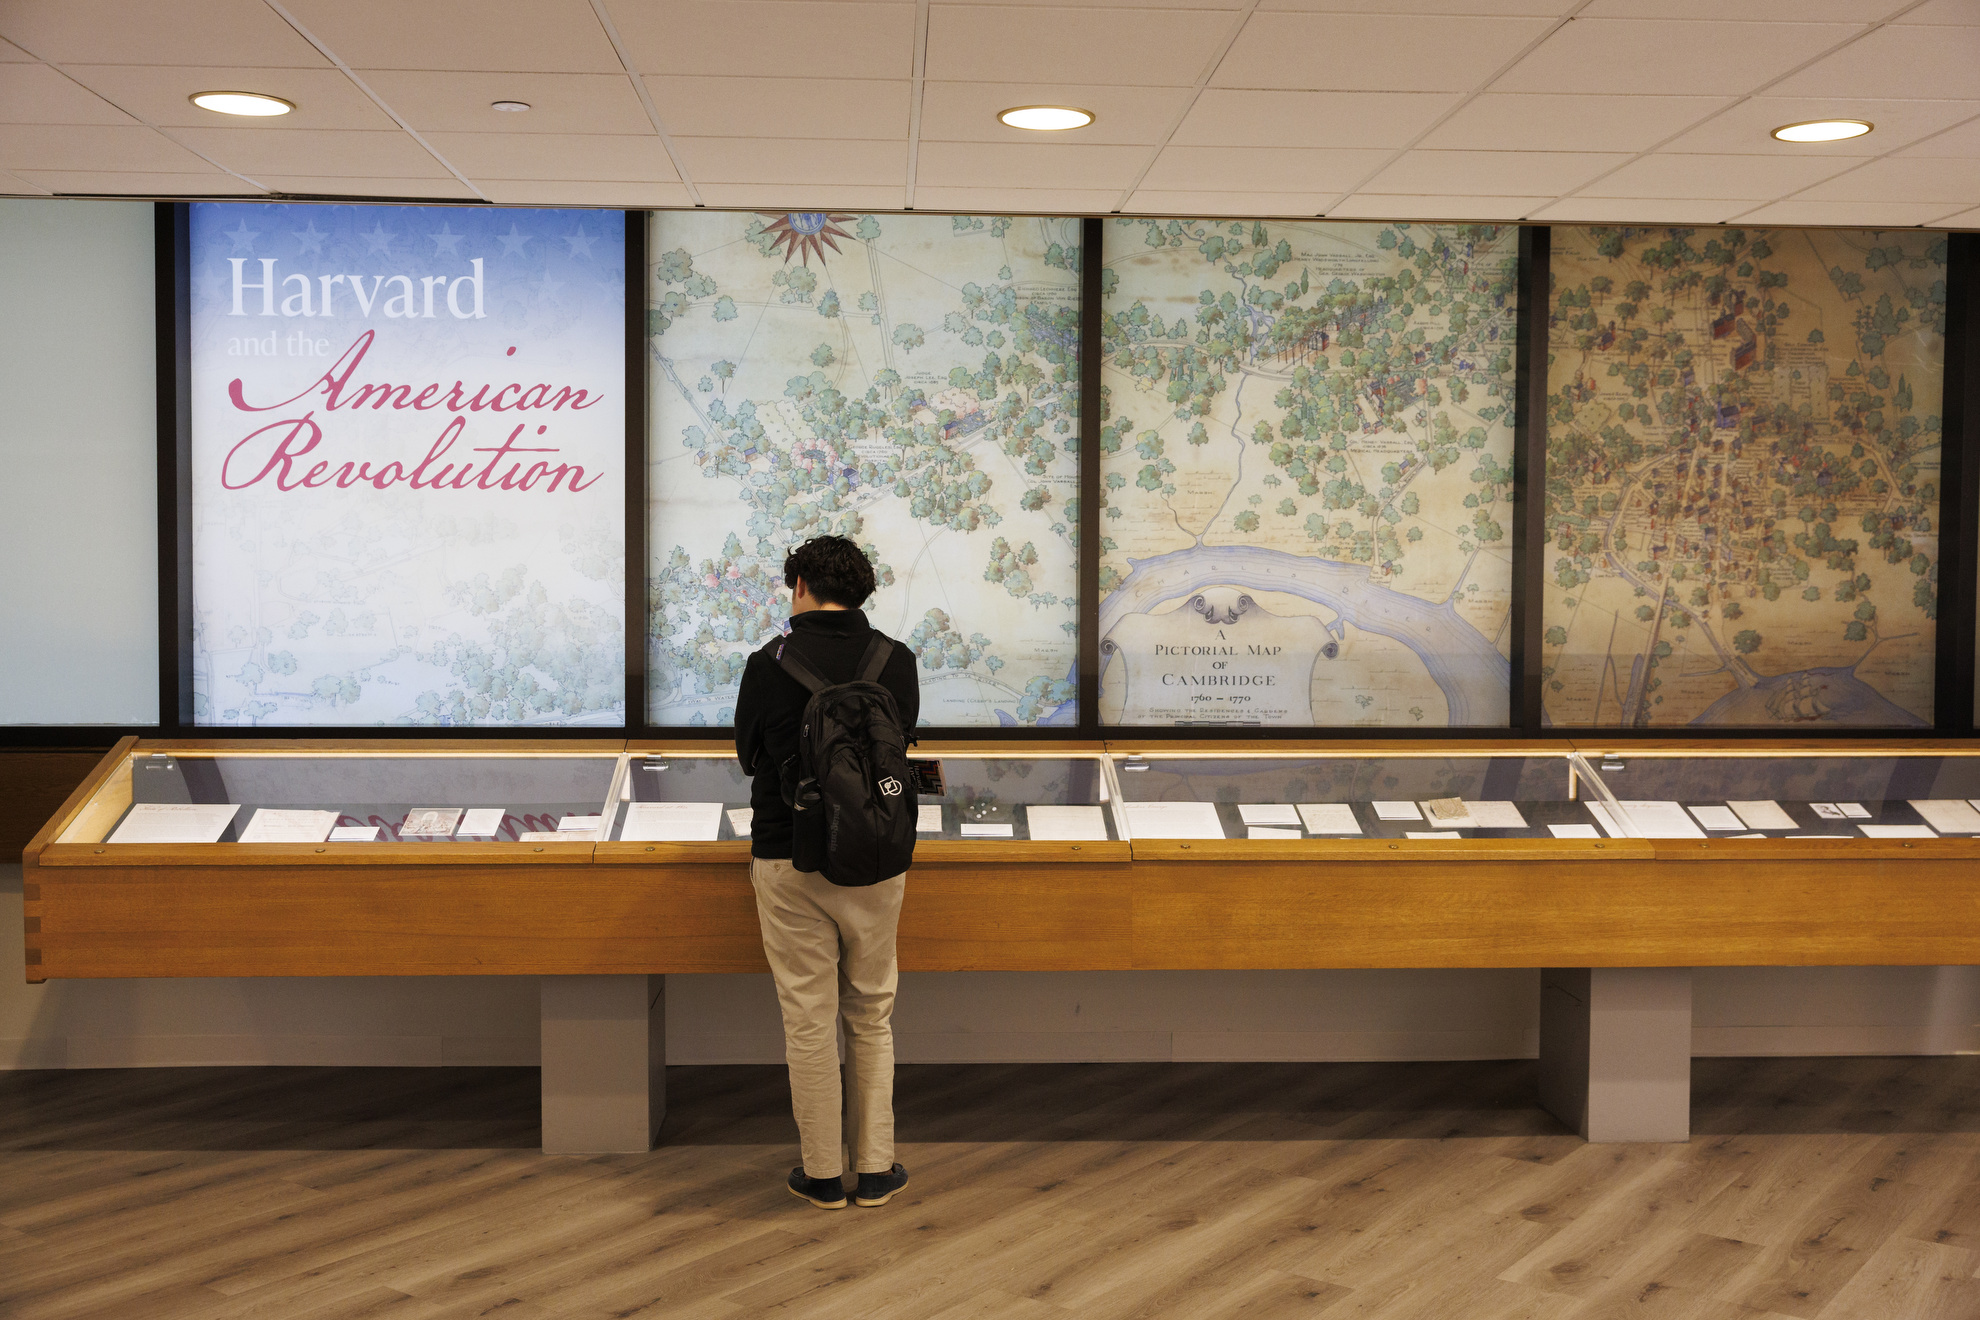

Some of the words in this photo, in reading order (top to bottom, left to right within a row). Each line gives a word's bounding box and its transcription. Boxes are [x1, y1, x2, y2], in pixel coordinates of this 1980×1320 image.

[227, 257, 487, 319] Harvard
[227, 331, 278, 356] and
[286, 331, 329, 357] the
[228, 329, 604, 412] American
[221, 411, 604, 492] Revolution
[1215, 630, 1226, 640] A
[1155, 645, 1238, 656] PICTORIAL
[1248, 645, 1282, 656] MAP
[1212, 661, 1228, 670] OF
[1162, 673, 1276, 686] CAMBRIDGE
[1191, 693, 1212, 704] 1760
[1229, 696, 1251, 704] 1770
[830, 803, 841, 852] patagonia
